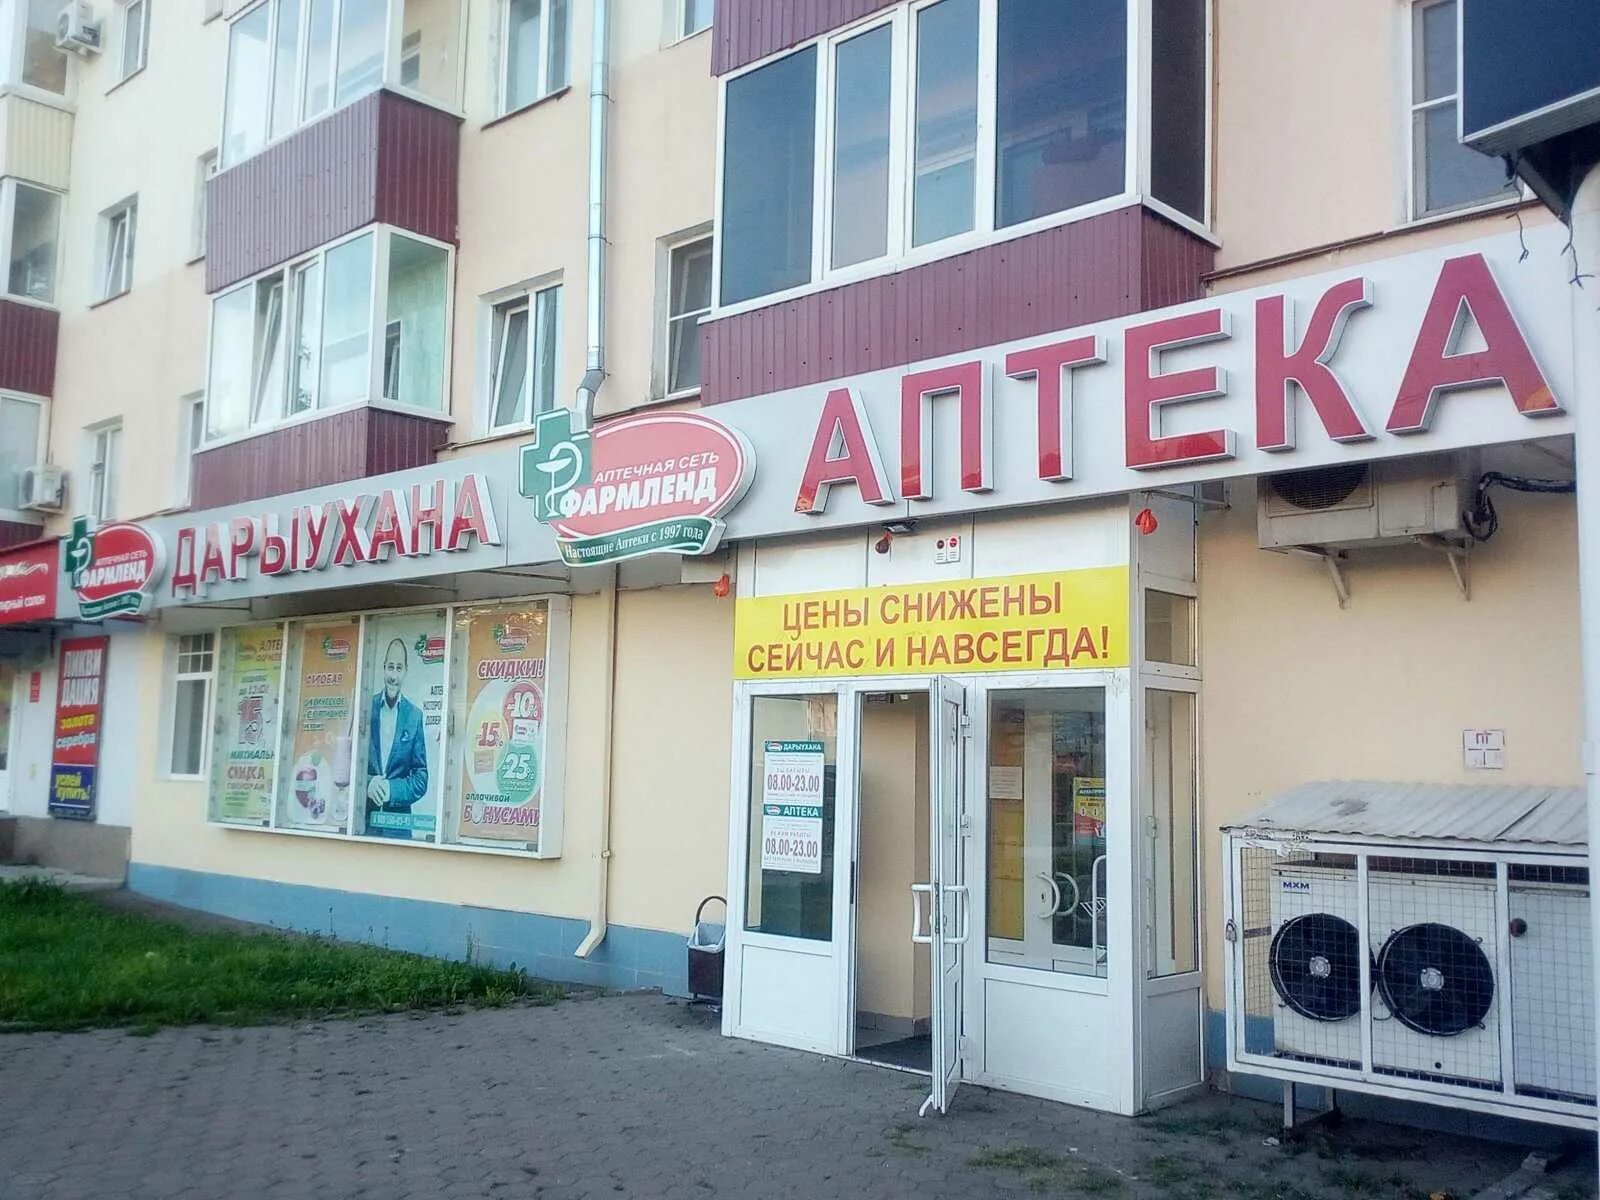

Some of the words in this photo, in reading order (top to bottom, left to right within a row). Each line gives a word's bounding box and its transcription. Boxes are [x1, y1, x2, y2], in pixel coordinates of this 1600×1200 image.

[794, 252, 1566, 514] АПТЕКА
[595, 460, 675, 483] АПТЕЧНАЯ
[678, 451, 720, 469] СЕТЬ
[559, 467, 717, 518] ФАРМЛЕНД
[172, 473, 500, 597] ДАРЫУХАНА
[564, 541, 614, 559] Настоящие
[615, 533, 650, 550] Аптеки
[651, 532, 657, 542] с
[659, 525, 682, 541] 1997
[683, 526, 704, 540] года
[80, 559, 146, 588] ФАРМЛЕНД
[783, 598, 869, 641] ЦЕНЫ
[880, 582, 1062, 625] СНИЖЕНЫ
[747, 634, 864, 673] СЕЙЧАС
[876, 638, 895, 667] И
[906, 626, 1109, 668] НАВСЕГДА!
[478, 659, 545, 681] СКИДКИ!
[783, 743, 822, 751] ДАРЫУХАНА
[767, 773, 820, 792] 08.00-23.00
[783, 806, 819, 817] АПТЕКА
[765, 838, 818, 858] 08.00-23.00
